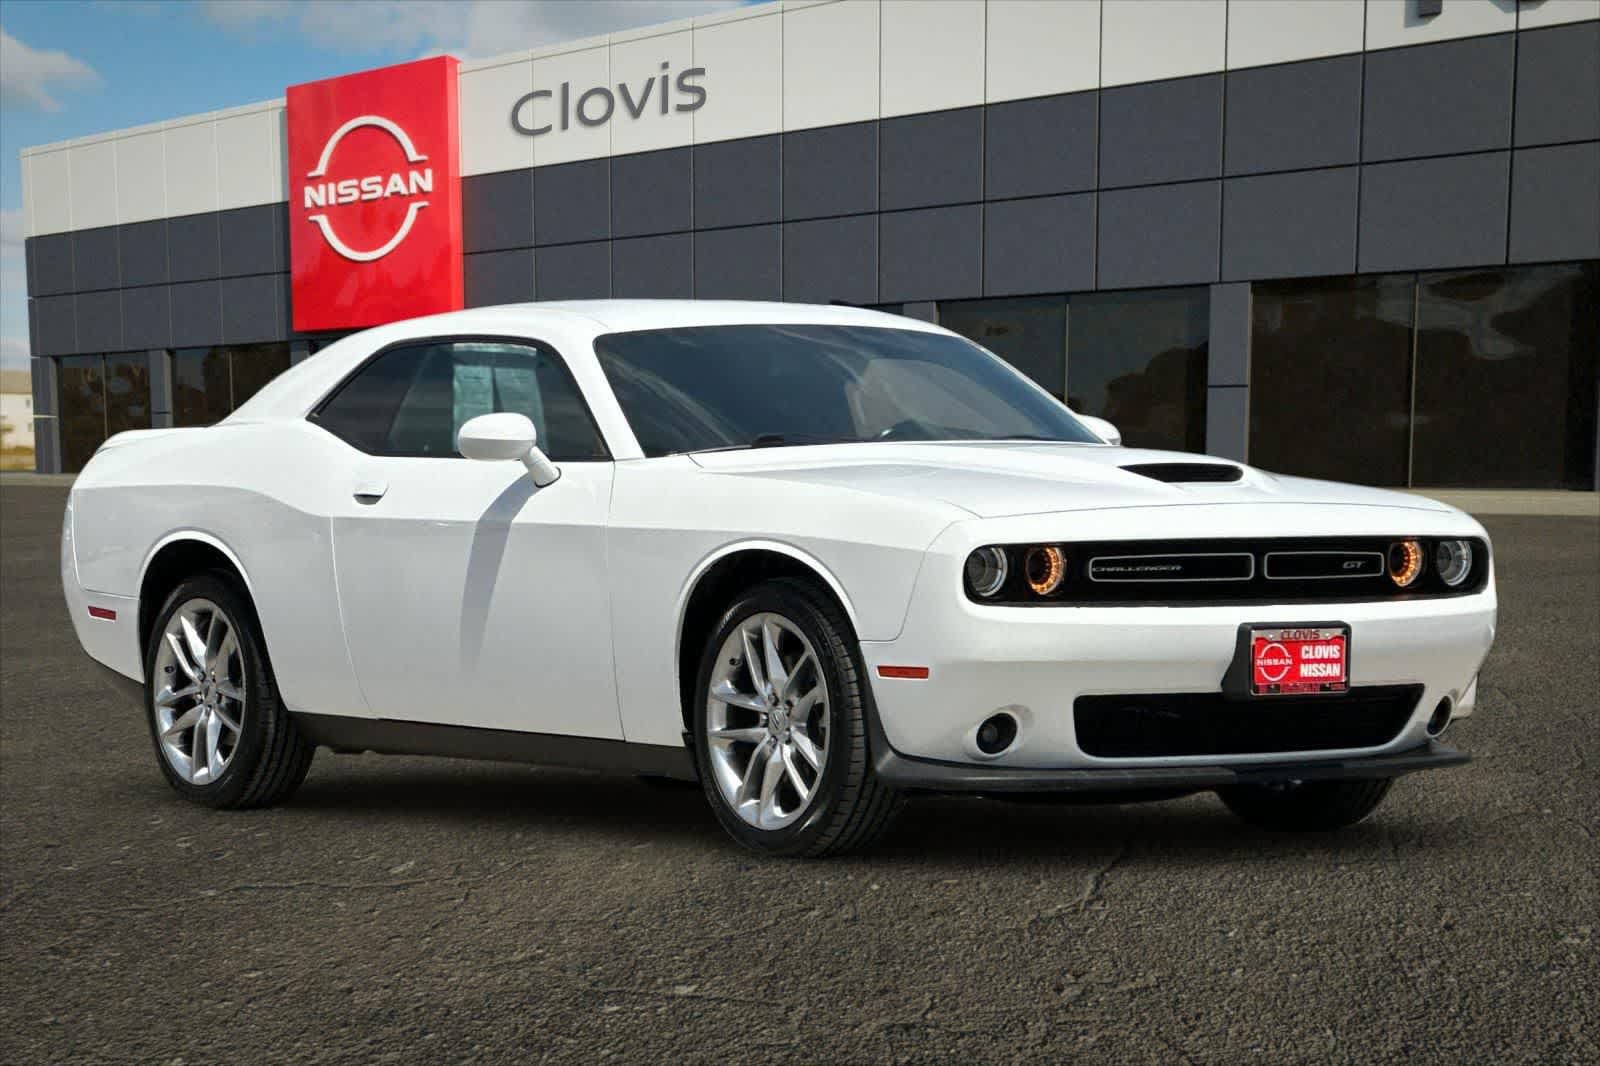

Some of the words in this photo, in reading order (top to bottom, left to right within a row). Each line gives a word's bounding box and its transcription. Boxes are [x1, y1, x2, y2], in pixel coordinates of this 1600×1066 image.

[511, 61, 707, 137] Clovis
[303, 168, 433, 209] NISSAN
[1342, 561, 1366, 569] GT
[1280, 630, 1320, 640] CLOVIS
[1301, 645, 1340, 659] CLOVIS
[1256, 657, 1292, 666] NISSAN
[1300, 663, 1340, 677] NISSAN
